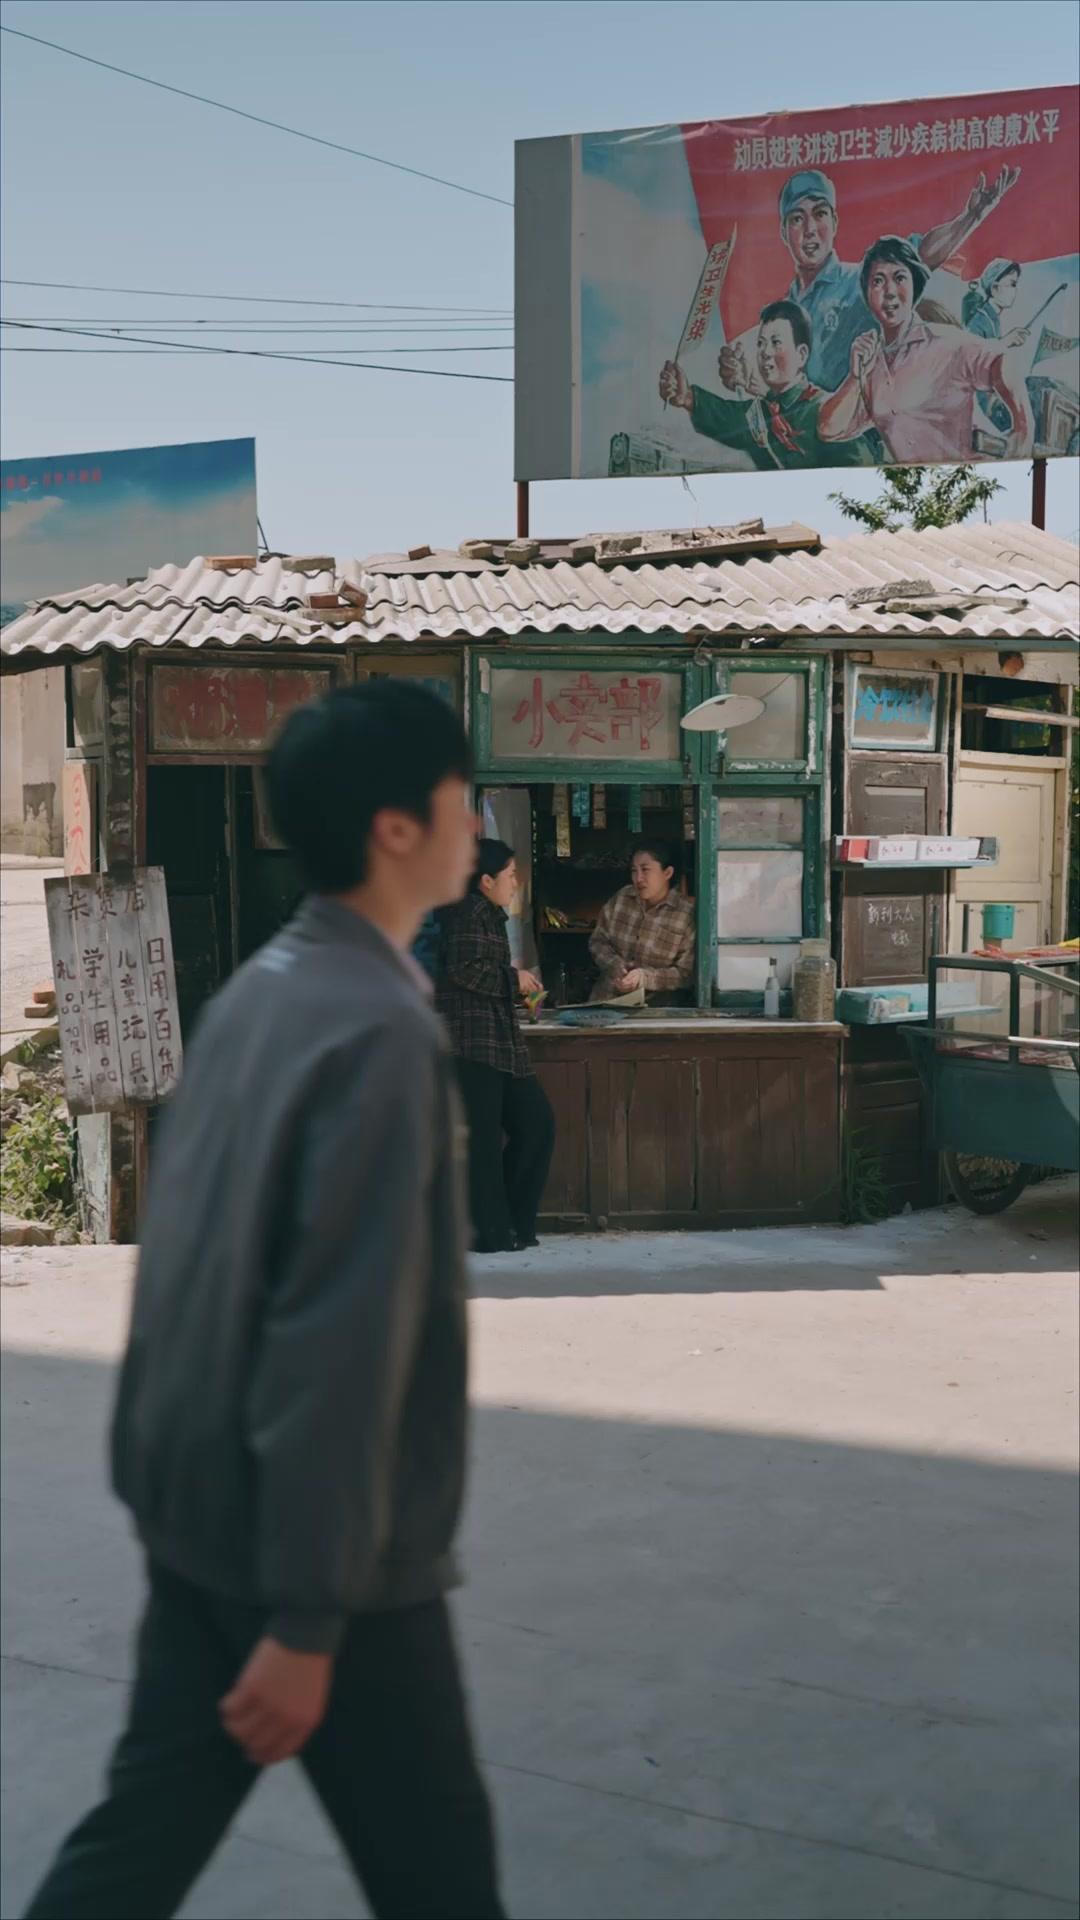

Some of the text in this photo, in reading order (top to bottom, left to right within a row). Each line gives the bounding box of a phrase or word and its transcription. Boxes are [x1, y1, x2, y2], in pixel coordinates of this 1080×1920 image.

[512, 672, 663, 751] 小卖部
[63, 881, 146, 921] 杂货店
[82, 947, 118, 1083] 学生用品
[117, 950, 149, 1084] 儿童玩具
[147, 937, 177, 1082] 日用百货
